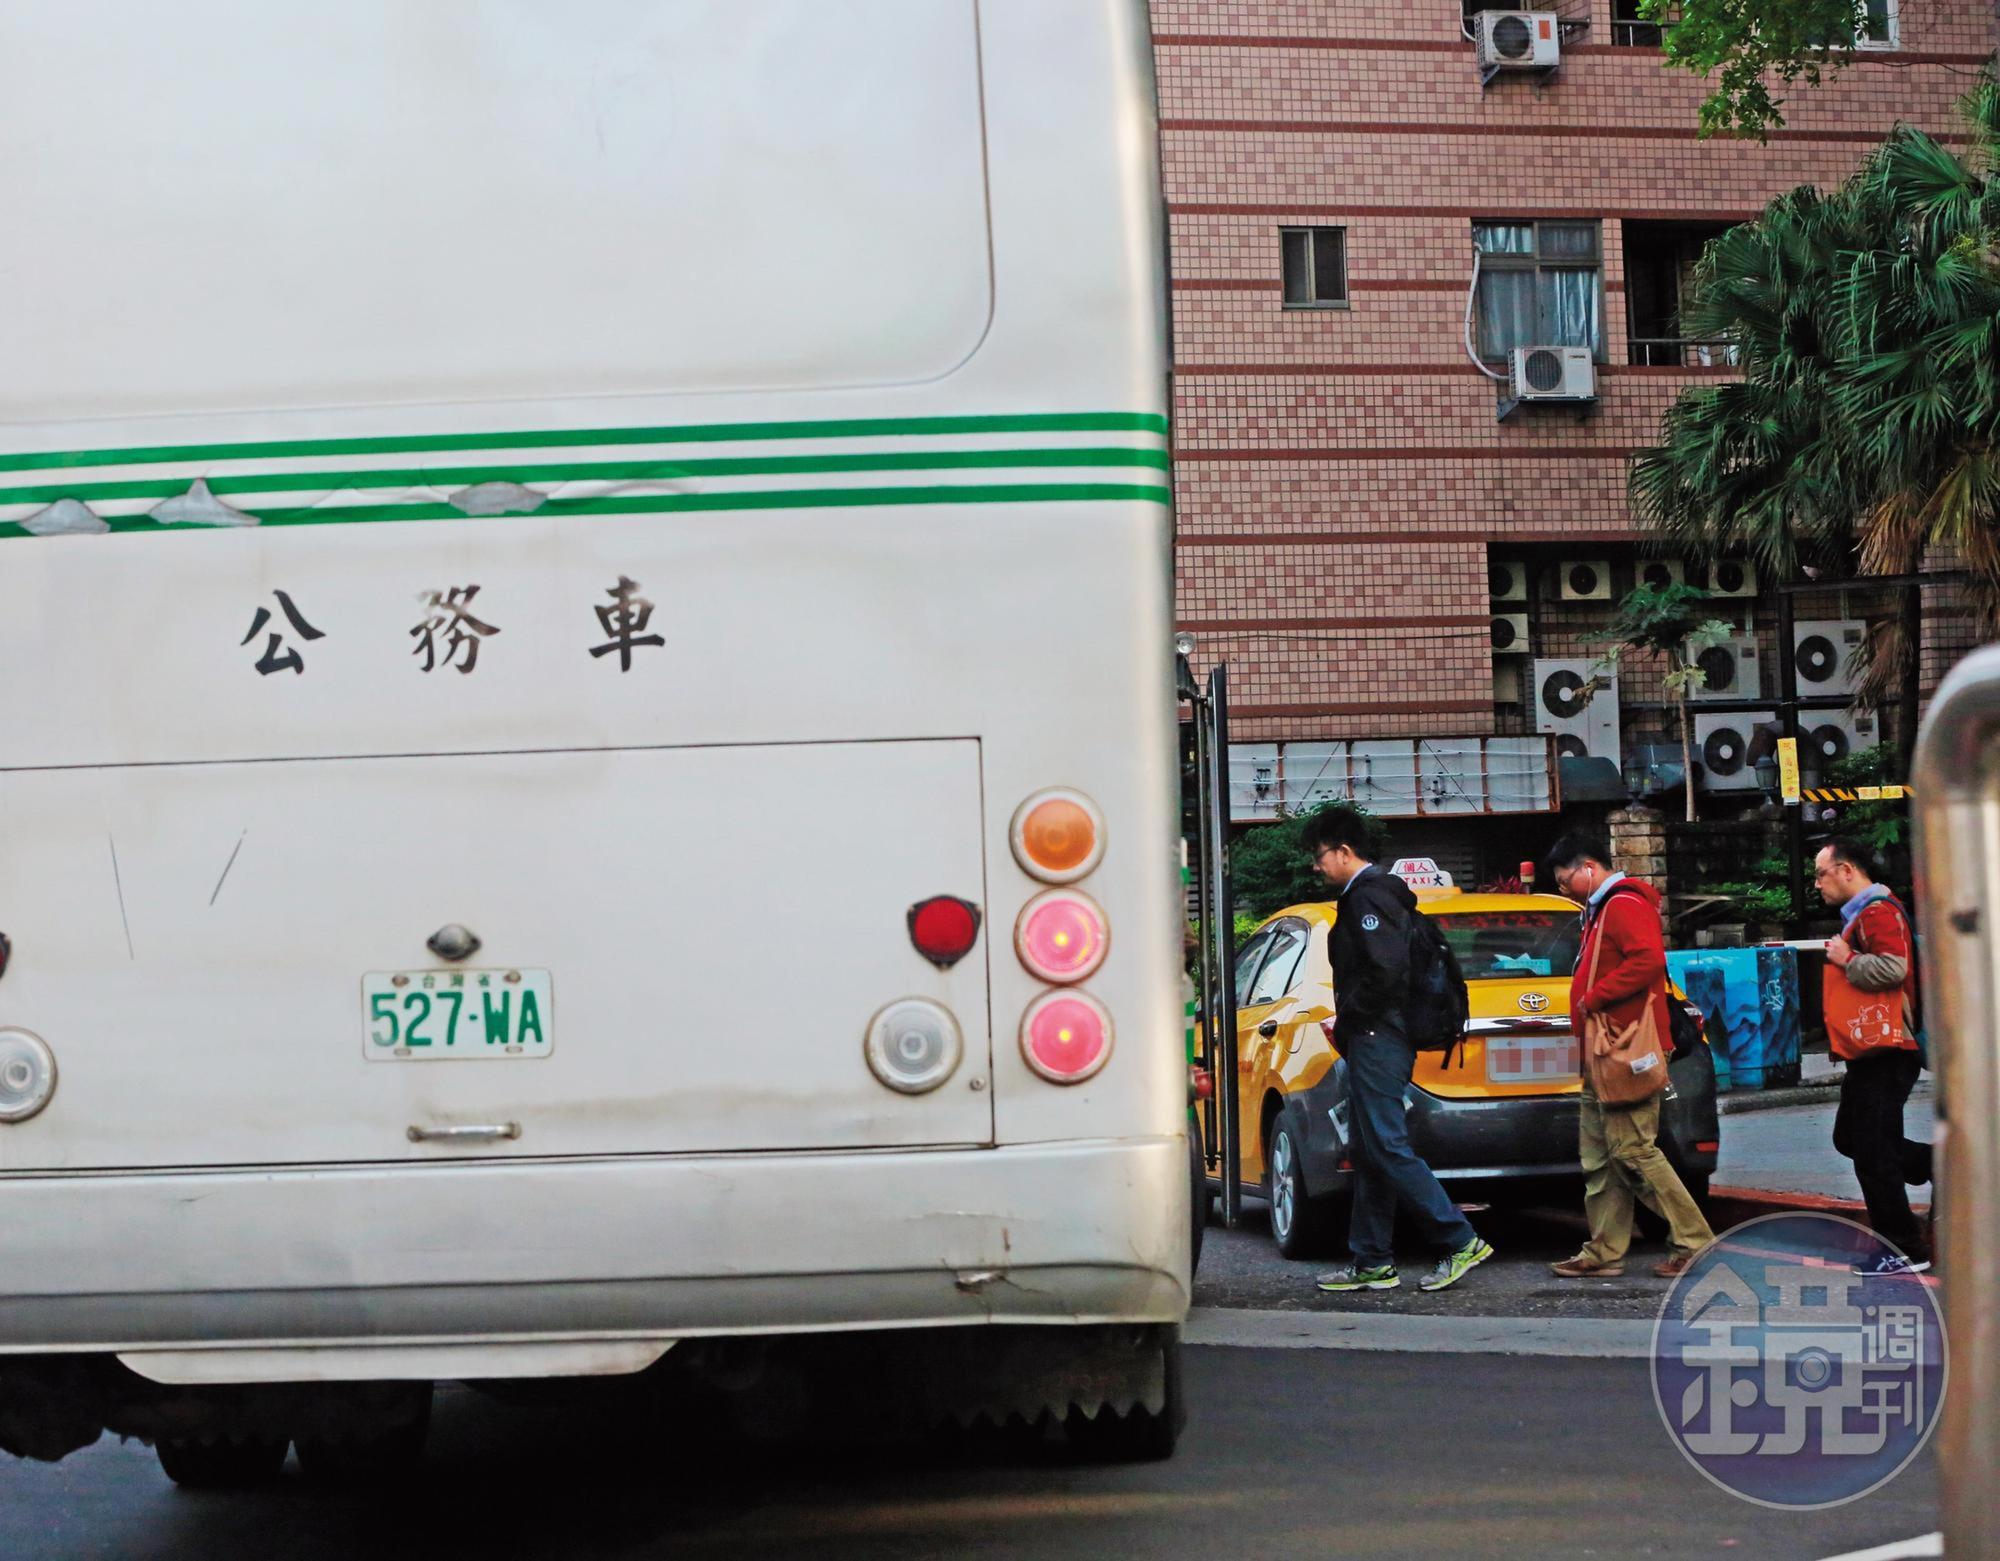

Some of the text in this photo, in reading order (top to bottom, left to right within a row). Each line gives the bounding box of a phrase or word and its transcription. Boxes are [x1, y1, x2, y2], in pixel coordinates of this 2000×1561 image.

[240, 576, 666, 676] 公務車
[1403, 861, 1429, 873] 個人
[1404, 877, 1431, 885] TAXI
[1433, 874, 1444, 886] 大
[422, 972, 491, 989] 台灣省
[371, 990, 544, 1047] 527-WA
